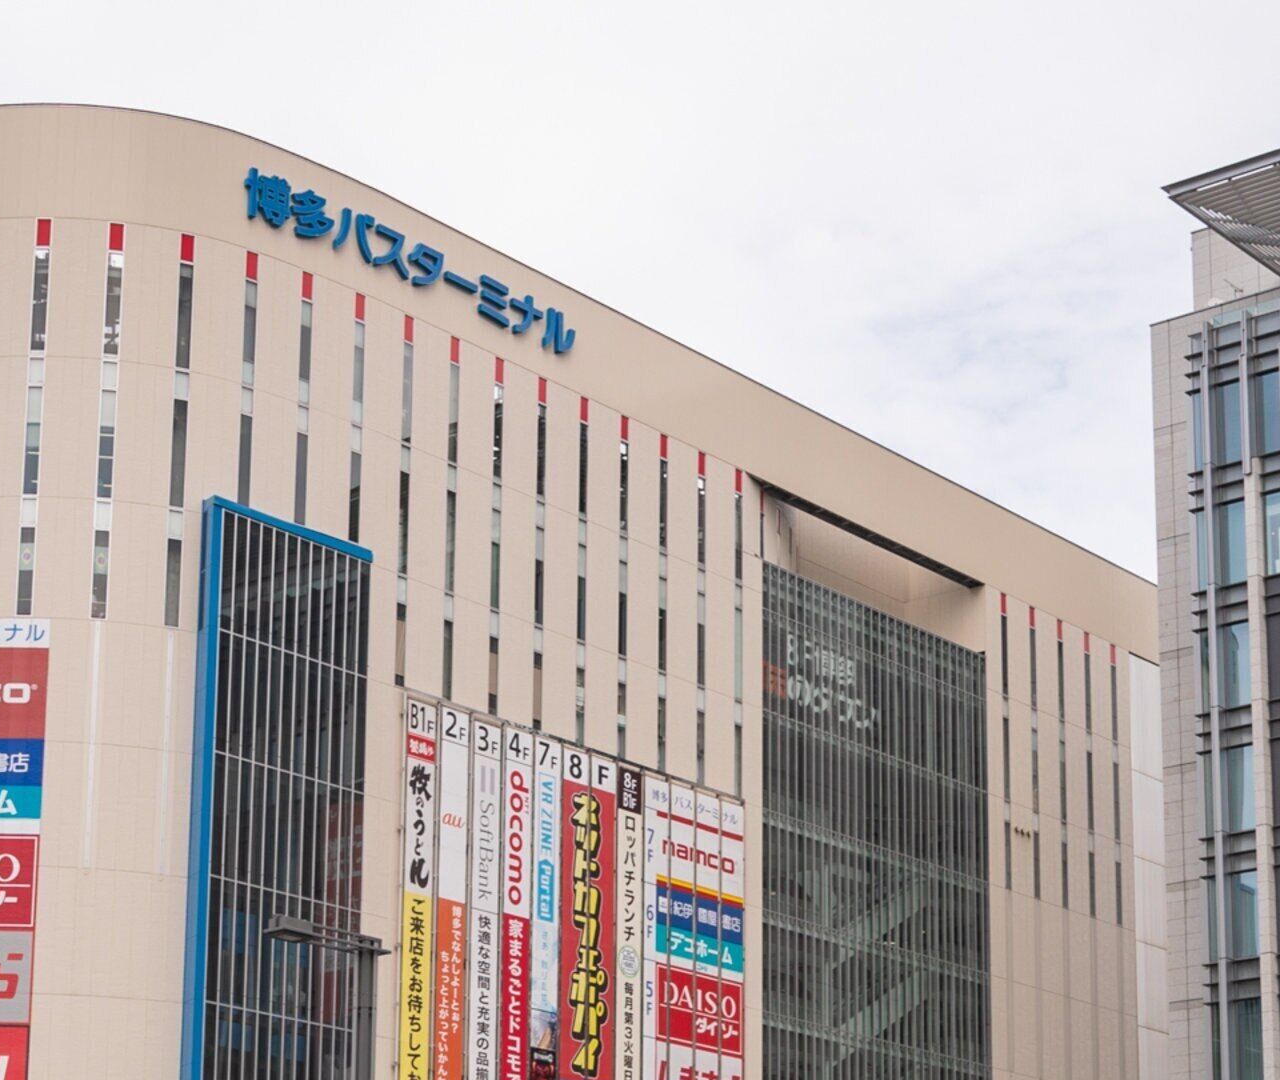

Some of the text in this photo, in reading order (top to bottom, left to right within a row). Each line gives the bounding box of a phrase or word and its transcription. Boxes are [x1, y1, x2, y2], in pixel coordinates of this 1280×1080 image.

[244, 167, 576, 354] 博多バスターミナル
[411, 703, 434, 733] B1F
[445, 711, 466, 740] 2F
[478, 725, 498, 754] 3F
[509, 733, 529, 760] 4F
[539, 741, 557, 769] 7F
[569, 754, 609, 785] 8F
[408, 764, 432, 888] 牧のうどん
[442, 813, 465, 828] au
[508, 770, 529, 905] docomo
[478, 799, 496, 902] SoftBank
[662, 839, 735, 875] namco
[540, 864, 553, 919] Portal
[623, 816, 637, 942] ロッパチランチ
[670, 931, 733, 965] デコホーム
[663, 981, 736, 1018] DAISO
[696, 1017, 739, 1039] ダイソー
